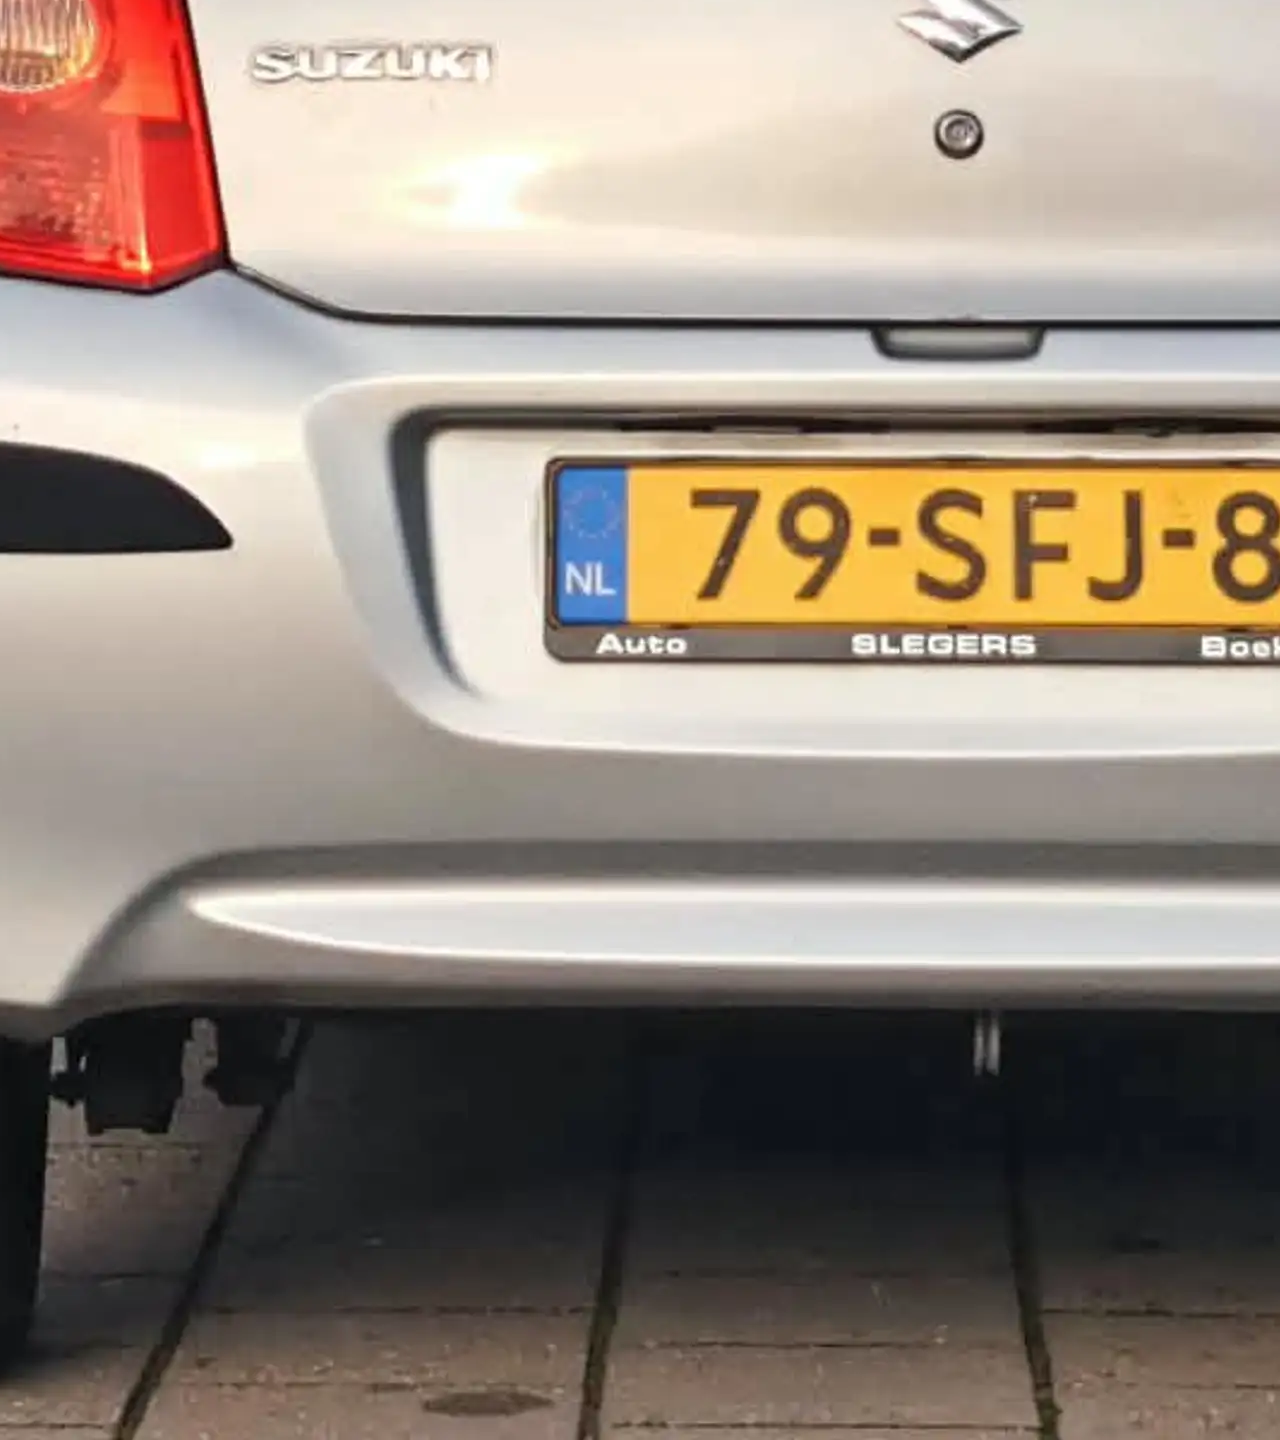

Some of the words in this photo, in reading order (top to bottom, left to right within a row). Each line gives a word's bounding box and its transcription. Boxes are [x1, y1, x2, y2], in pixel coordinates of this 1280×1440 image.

[250, 44, 494, 82] SUZUKI
[564, 561, 617, 596] NL
[595, 633, 688, 655] Auto
[851, 633, 1036, 656] SLEGERS
